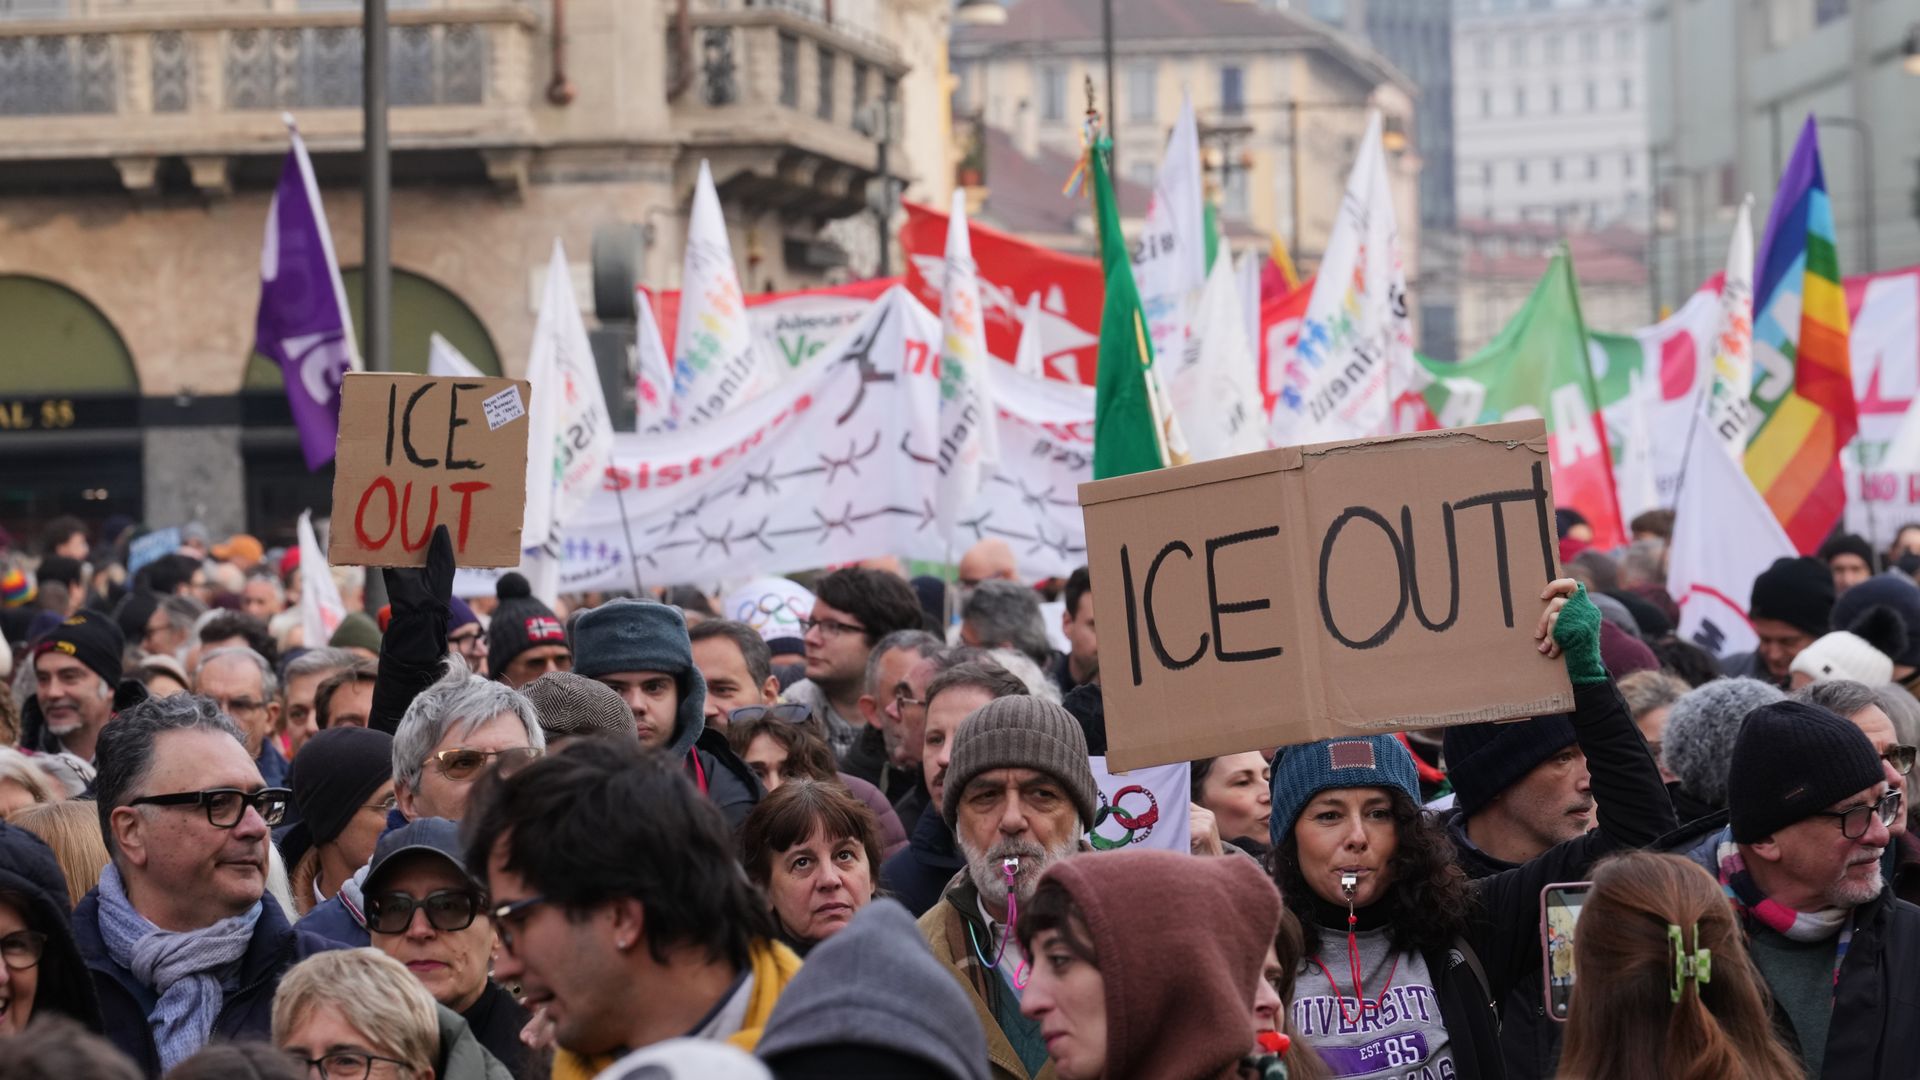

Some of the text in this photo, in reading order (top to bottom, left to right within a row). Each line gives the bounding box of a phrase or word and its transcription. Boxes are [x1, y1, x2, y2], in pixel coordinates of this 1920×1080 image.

[386, 382, 486, 470] ICE
[354, 476, 492, 554] OUT
[1121, 525, 1284, 686] ICE
[1360, 1043, 1383, 1061] EST.
[1383, 1034, 1420, 1068] 85
